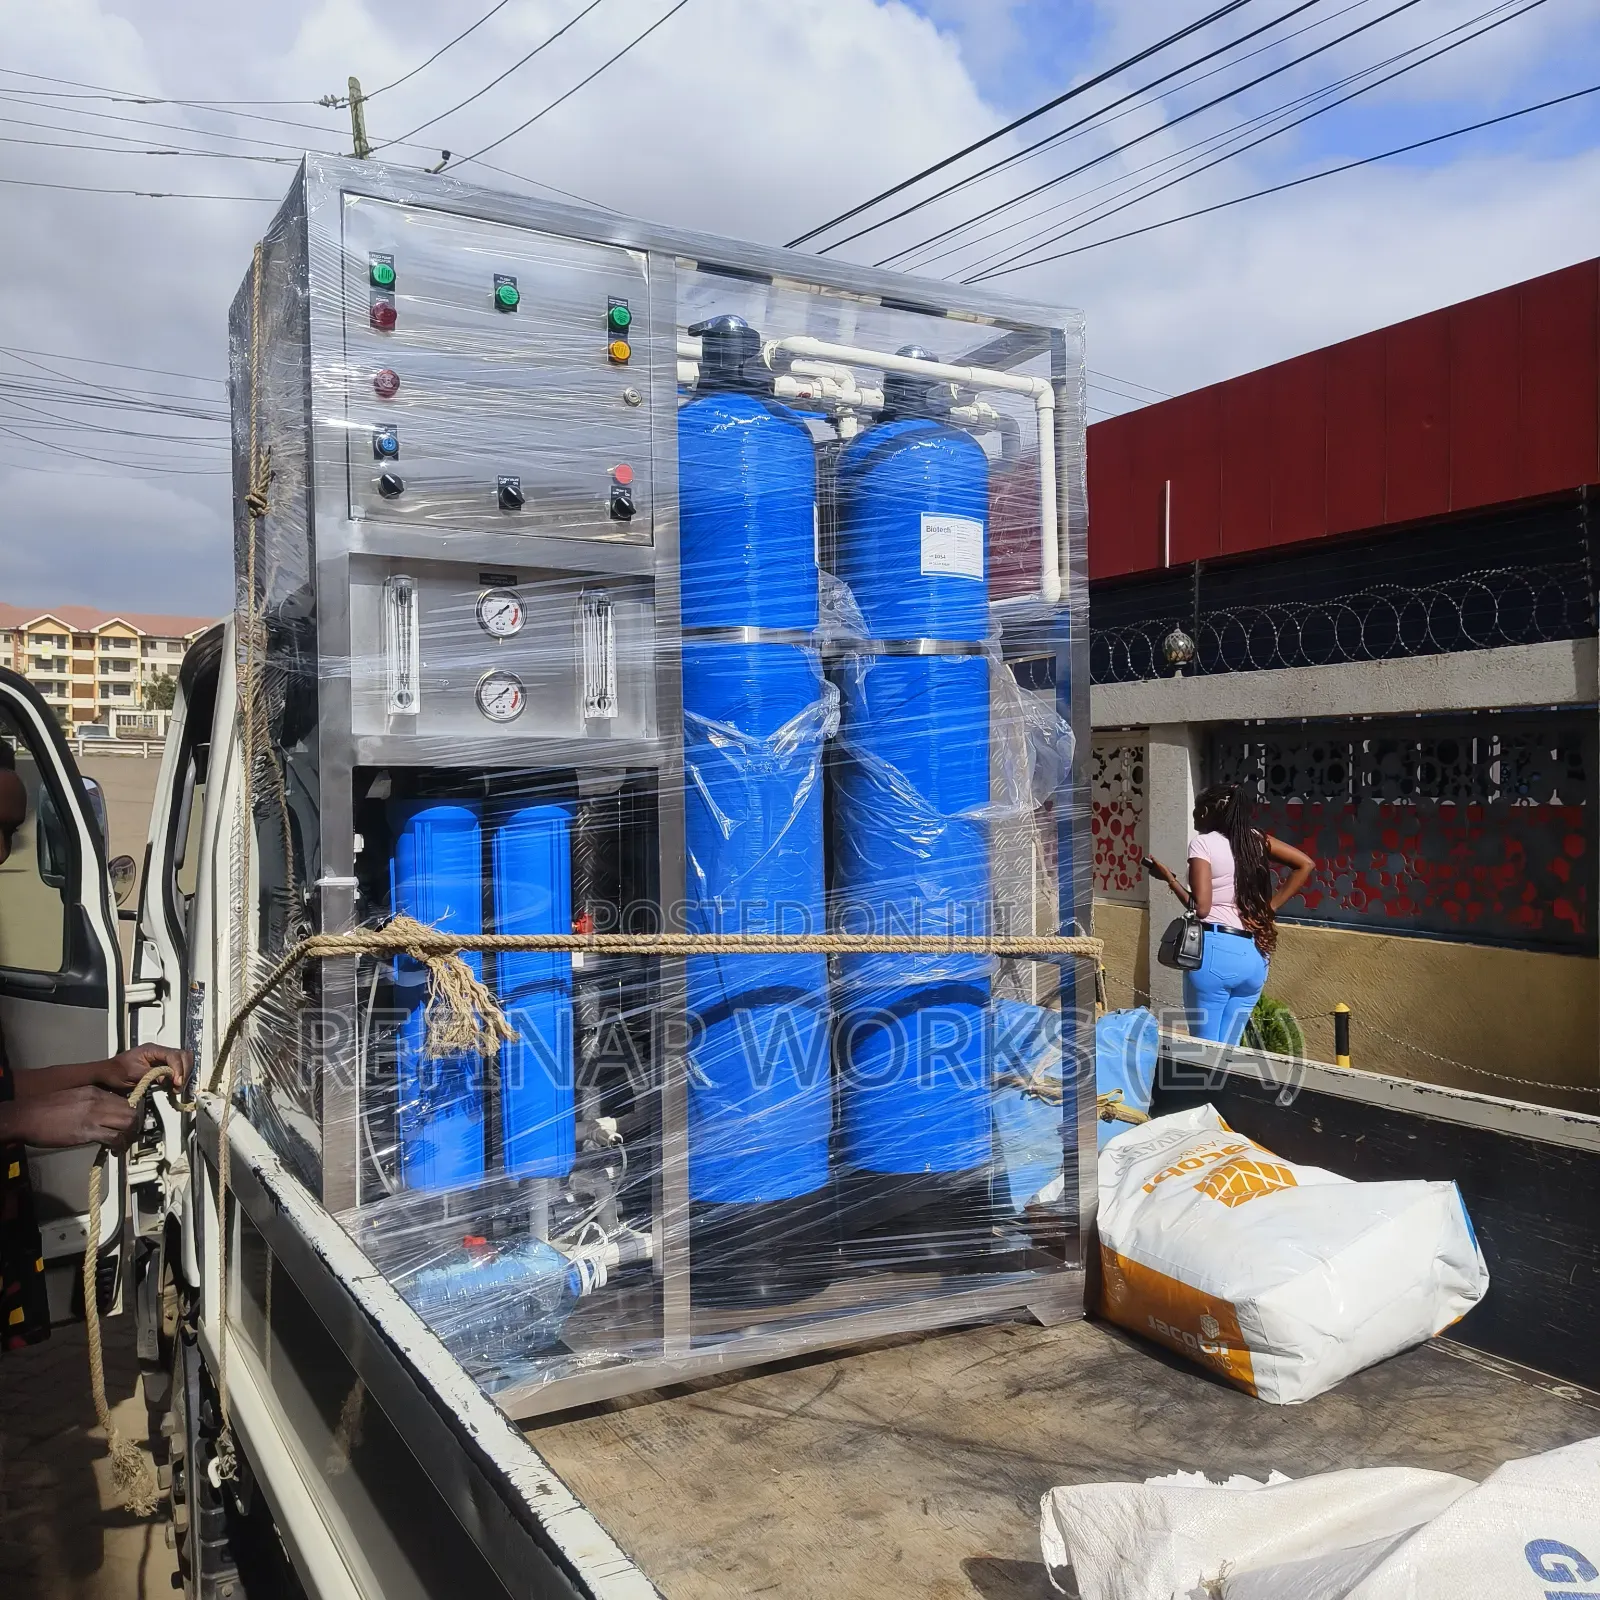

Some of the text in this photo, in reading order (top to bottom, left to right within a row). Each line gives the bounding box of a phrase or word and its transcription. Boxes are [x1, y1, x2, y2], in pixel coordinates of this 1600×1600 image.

[925, 525, 952, 533] Biotech
[1147, 1315, 1229, 1355] Jacobi
[1175, 1341, 1233, 1370] CONS
